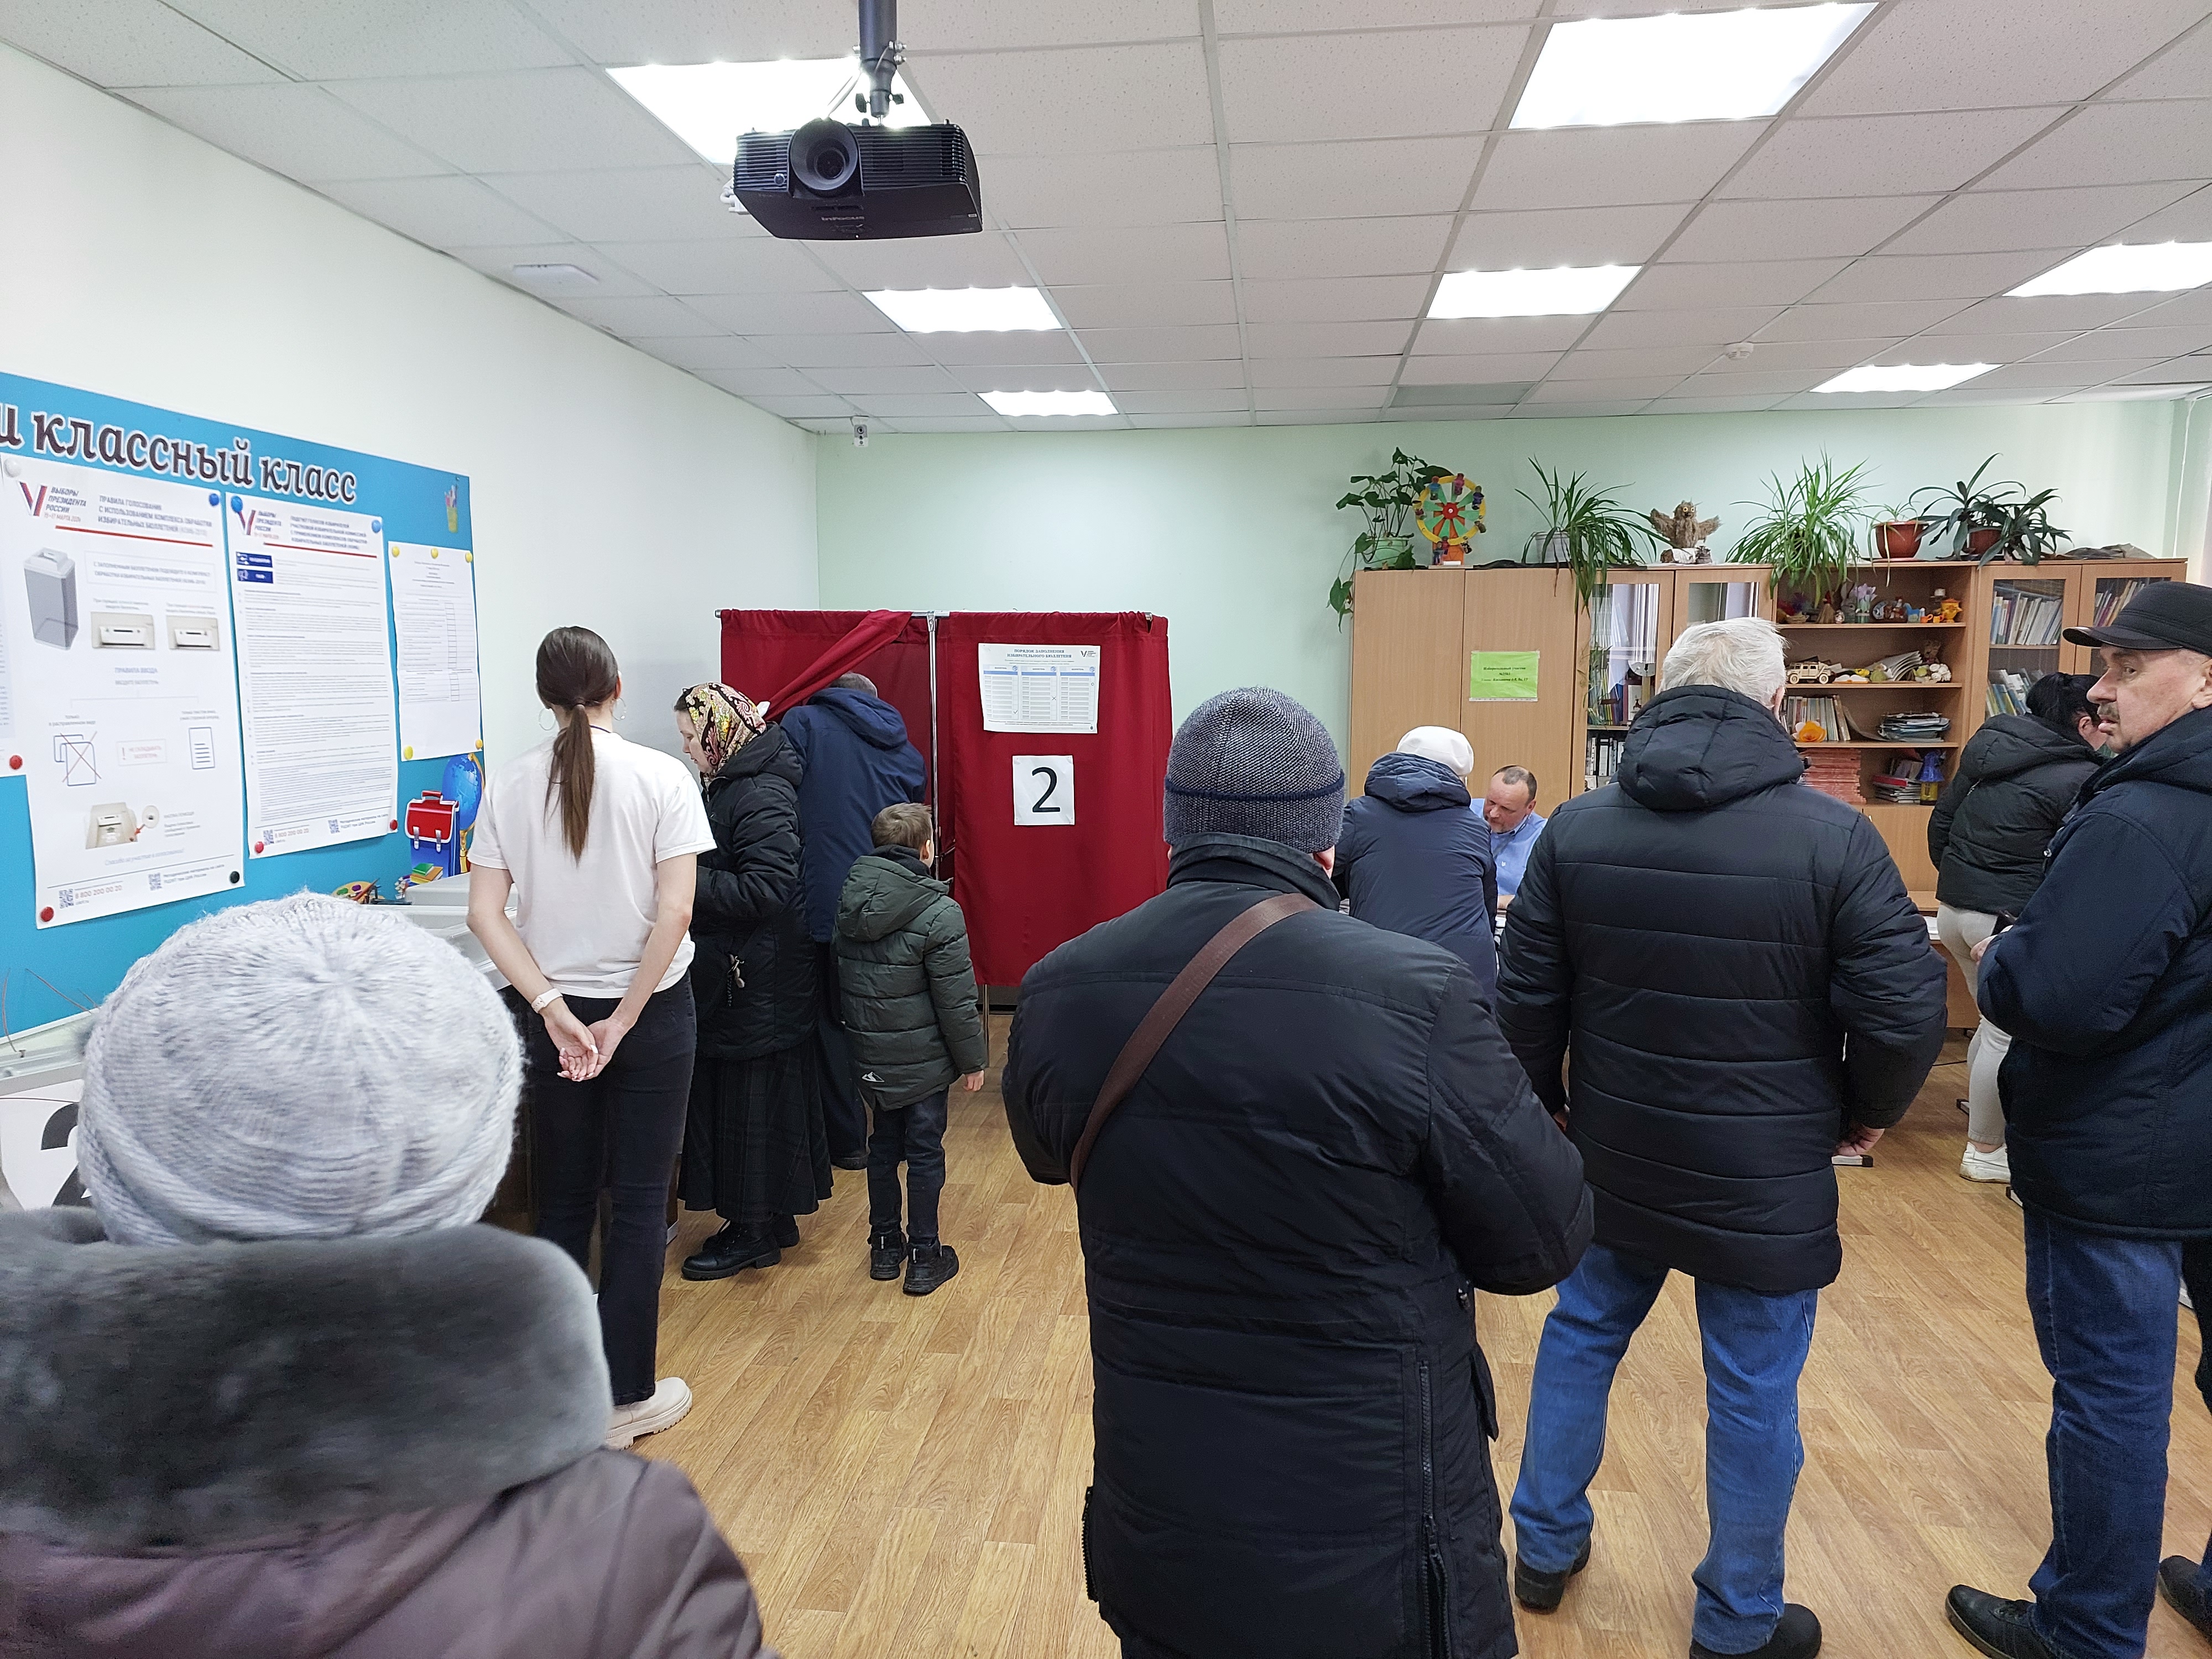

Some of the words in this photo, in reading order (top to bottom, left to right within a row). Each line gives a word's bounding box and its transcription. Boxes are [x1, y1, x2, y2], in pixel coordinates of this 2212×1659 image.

[33, 414, 253, 486] классный
[260, 459, 356, 503] класс
[51, 487, 79, 496] ВЫБОРЫ
[48, 495, 87, 507] ПРЕЗИДЕНТА
[45, 504, 70, 513] РОССИИ
[1031, 766, 1061, 813] 2
